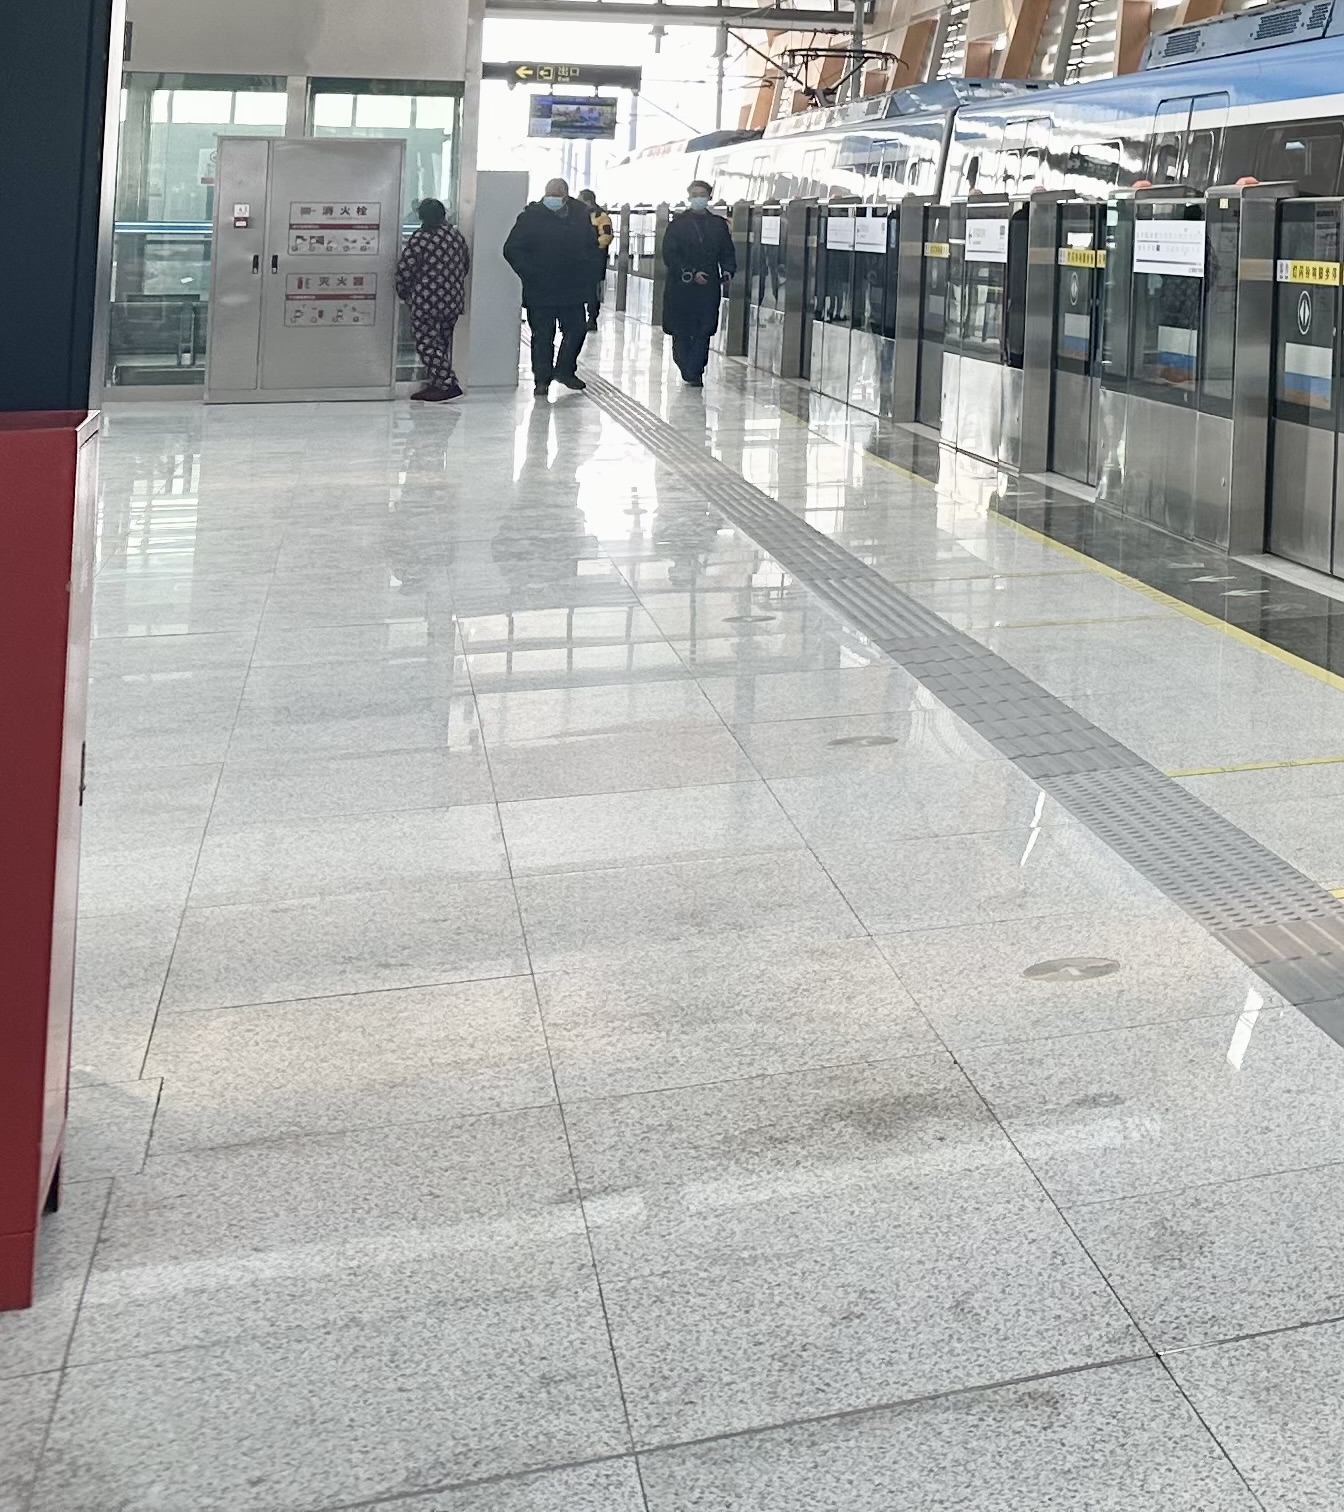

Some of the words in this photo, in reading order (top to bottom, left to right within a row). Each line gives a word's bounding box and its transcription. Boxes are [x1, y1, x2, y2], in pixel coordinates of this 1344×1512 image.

[558, 66, 579, 76] 出口
[322, 206, 368, 217] 消火栓
